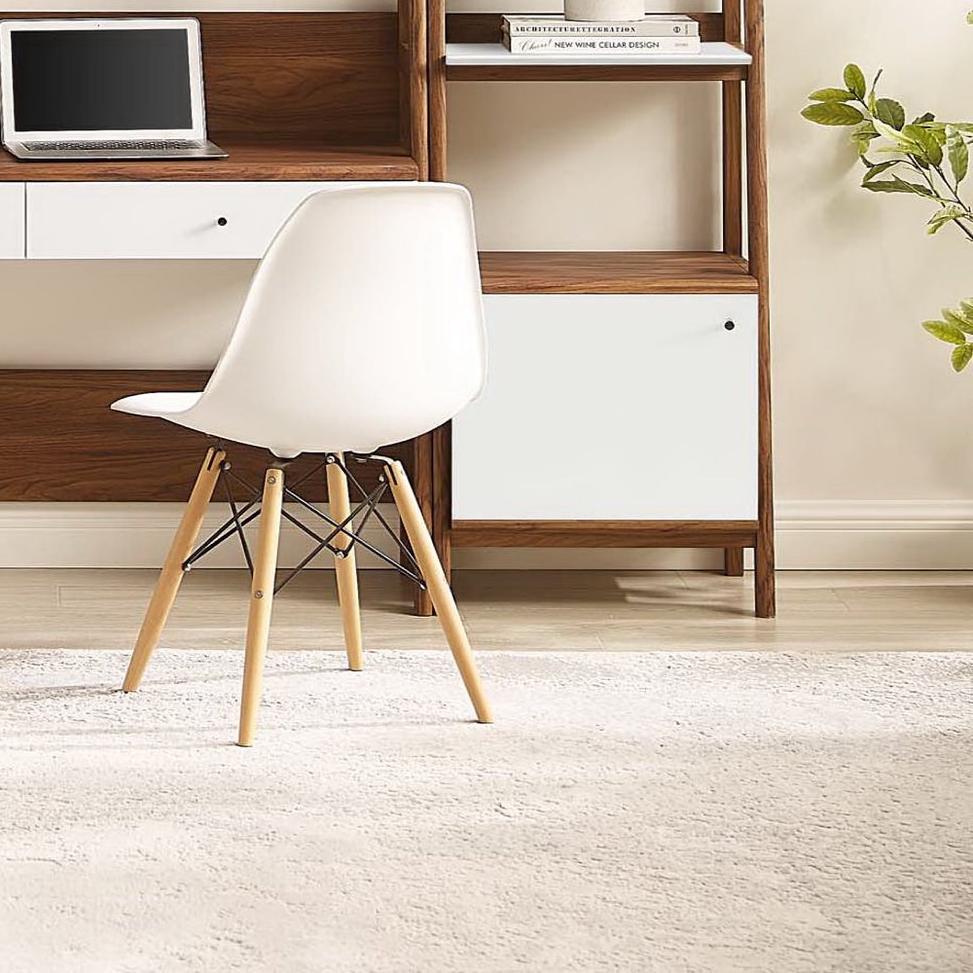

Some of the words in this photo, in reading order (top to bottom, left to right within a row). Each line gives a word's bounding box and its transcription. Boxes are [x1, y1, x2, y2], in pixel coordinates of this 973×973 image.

[554, 41, 573, 49] NEW
[575, 41, 597, 49] WINE
[598, 41, 627, 49] CELLAR
[628, 41, 660, 49] DESIGN
